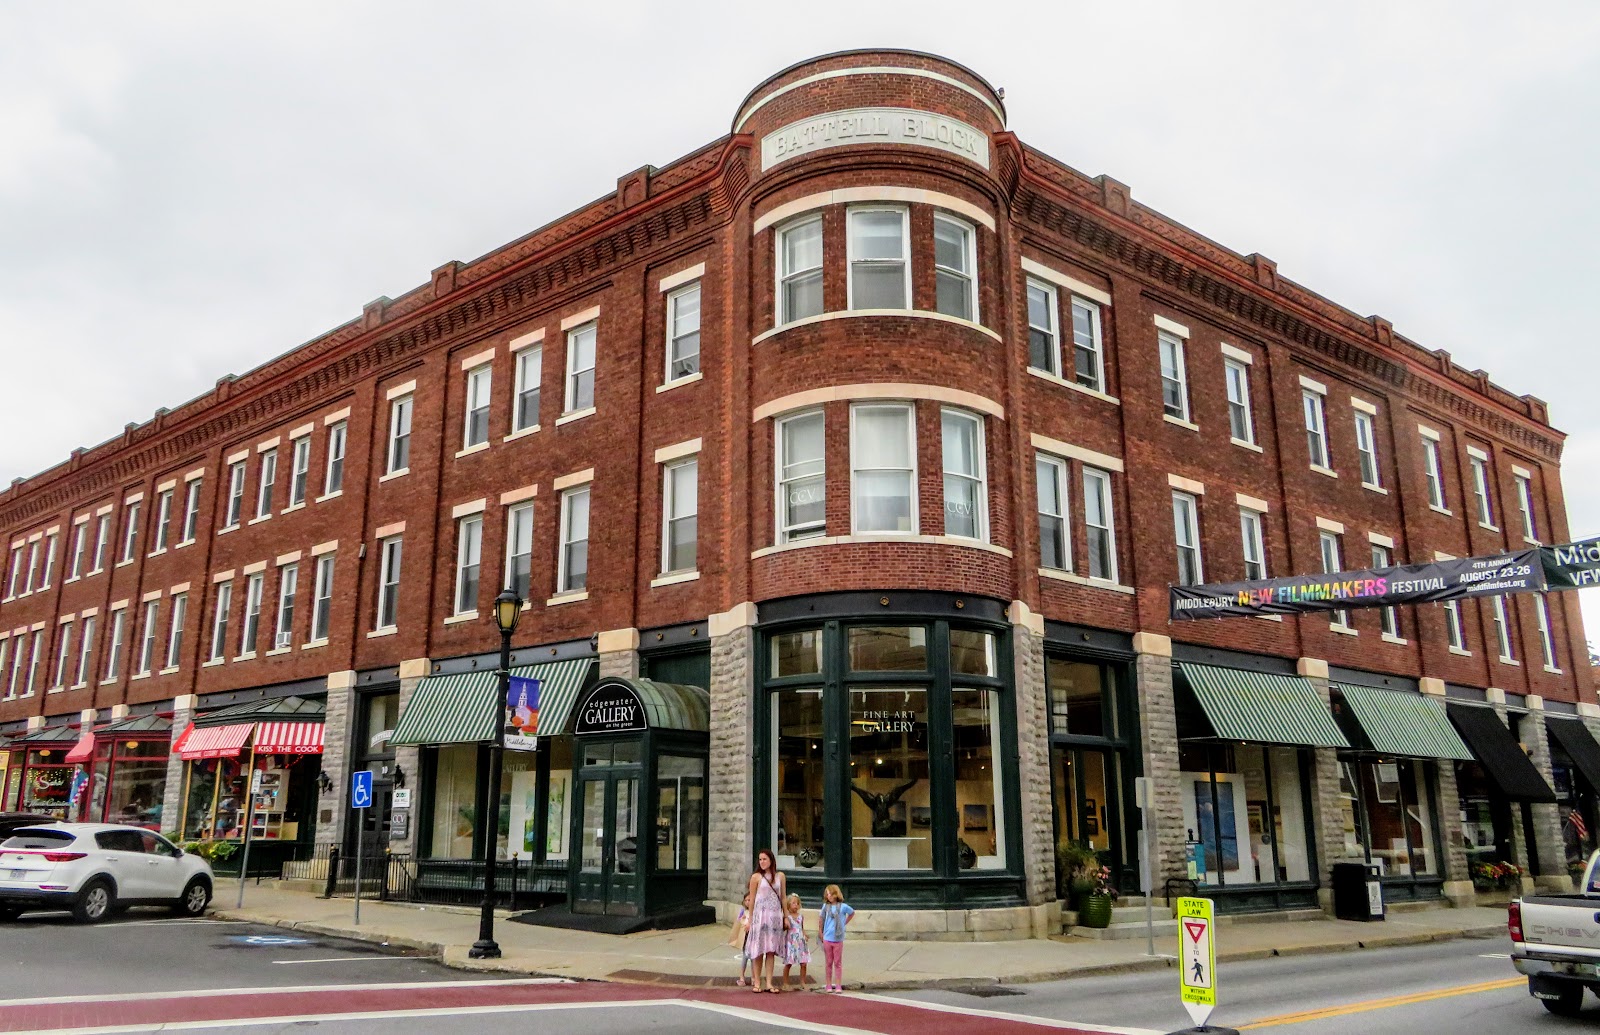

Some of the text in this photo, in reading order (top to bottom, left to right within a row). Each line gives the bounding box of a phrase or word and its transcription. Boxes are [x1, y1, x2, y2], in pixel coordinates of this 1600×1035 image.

[774, 116, 979, 158] BATTELL BLOCK
[790, 487, 816, 504] CCV
[947, 501, 971, 514] CCV
[1488, 558, 1516, 567] ANNUAL
[1459, 565, 1531, 583] AUGUST 23-26
[1466, 579, 1526, 592] middfilmfest.org
[1176, 577, 1448, 610] MIDDLEBURY NEW FILMMAKERS FESTIVAL
[589, 698, 634, 709] edgewater
[585, 706, 636, 724] GALLERY
[863, 710, 915, 719] FINE ART
[862, 721, 916, 733] GALLERY
[258, 745, 319, 753] KISS THE COOK
[1184, 900, 1204, 908] STATE
[1184, 994, 1212, 1002] CROSSWALK
